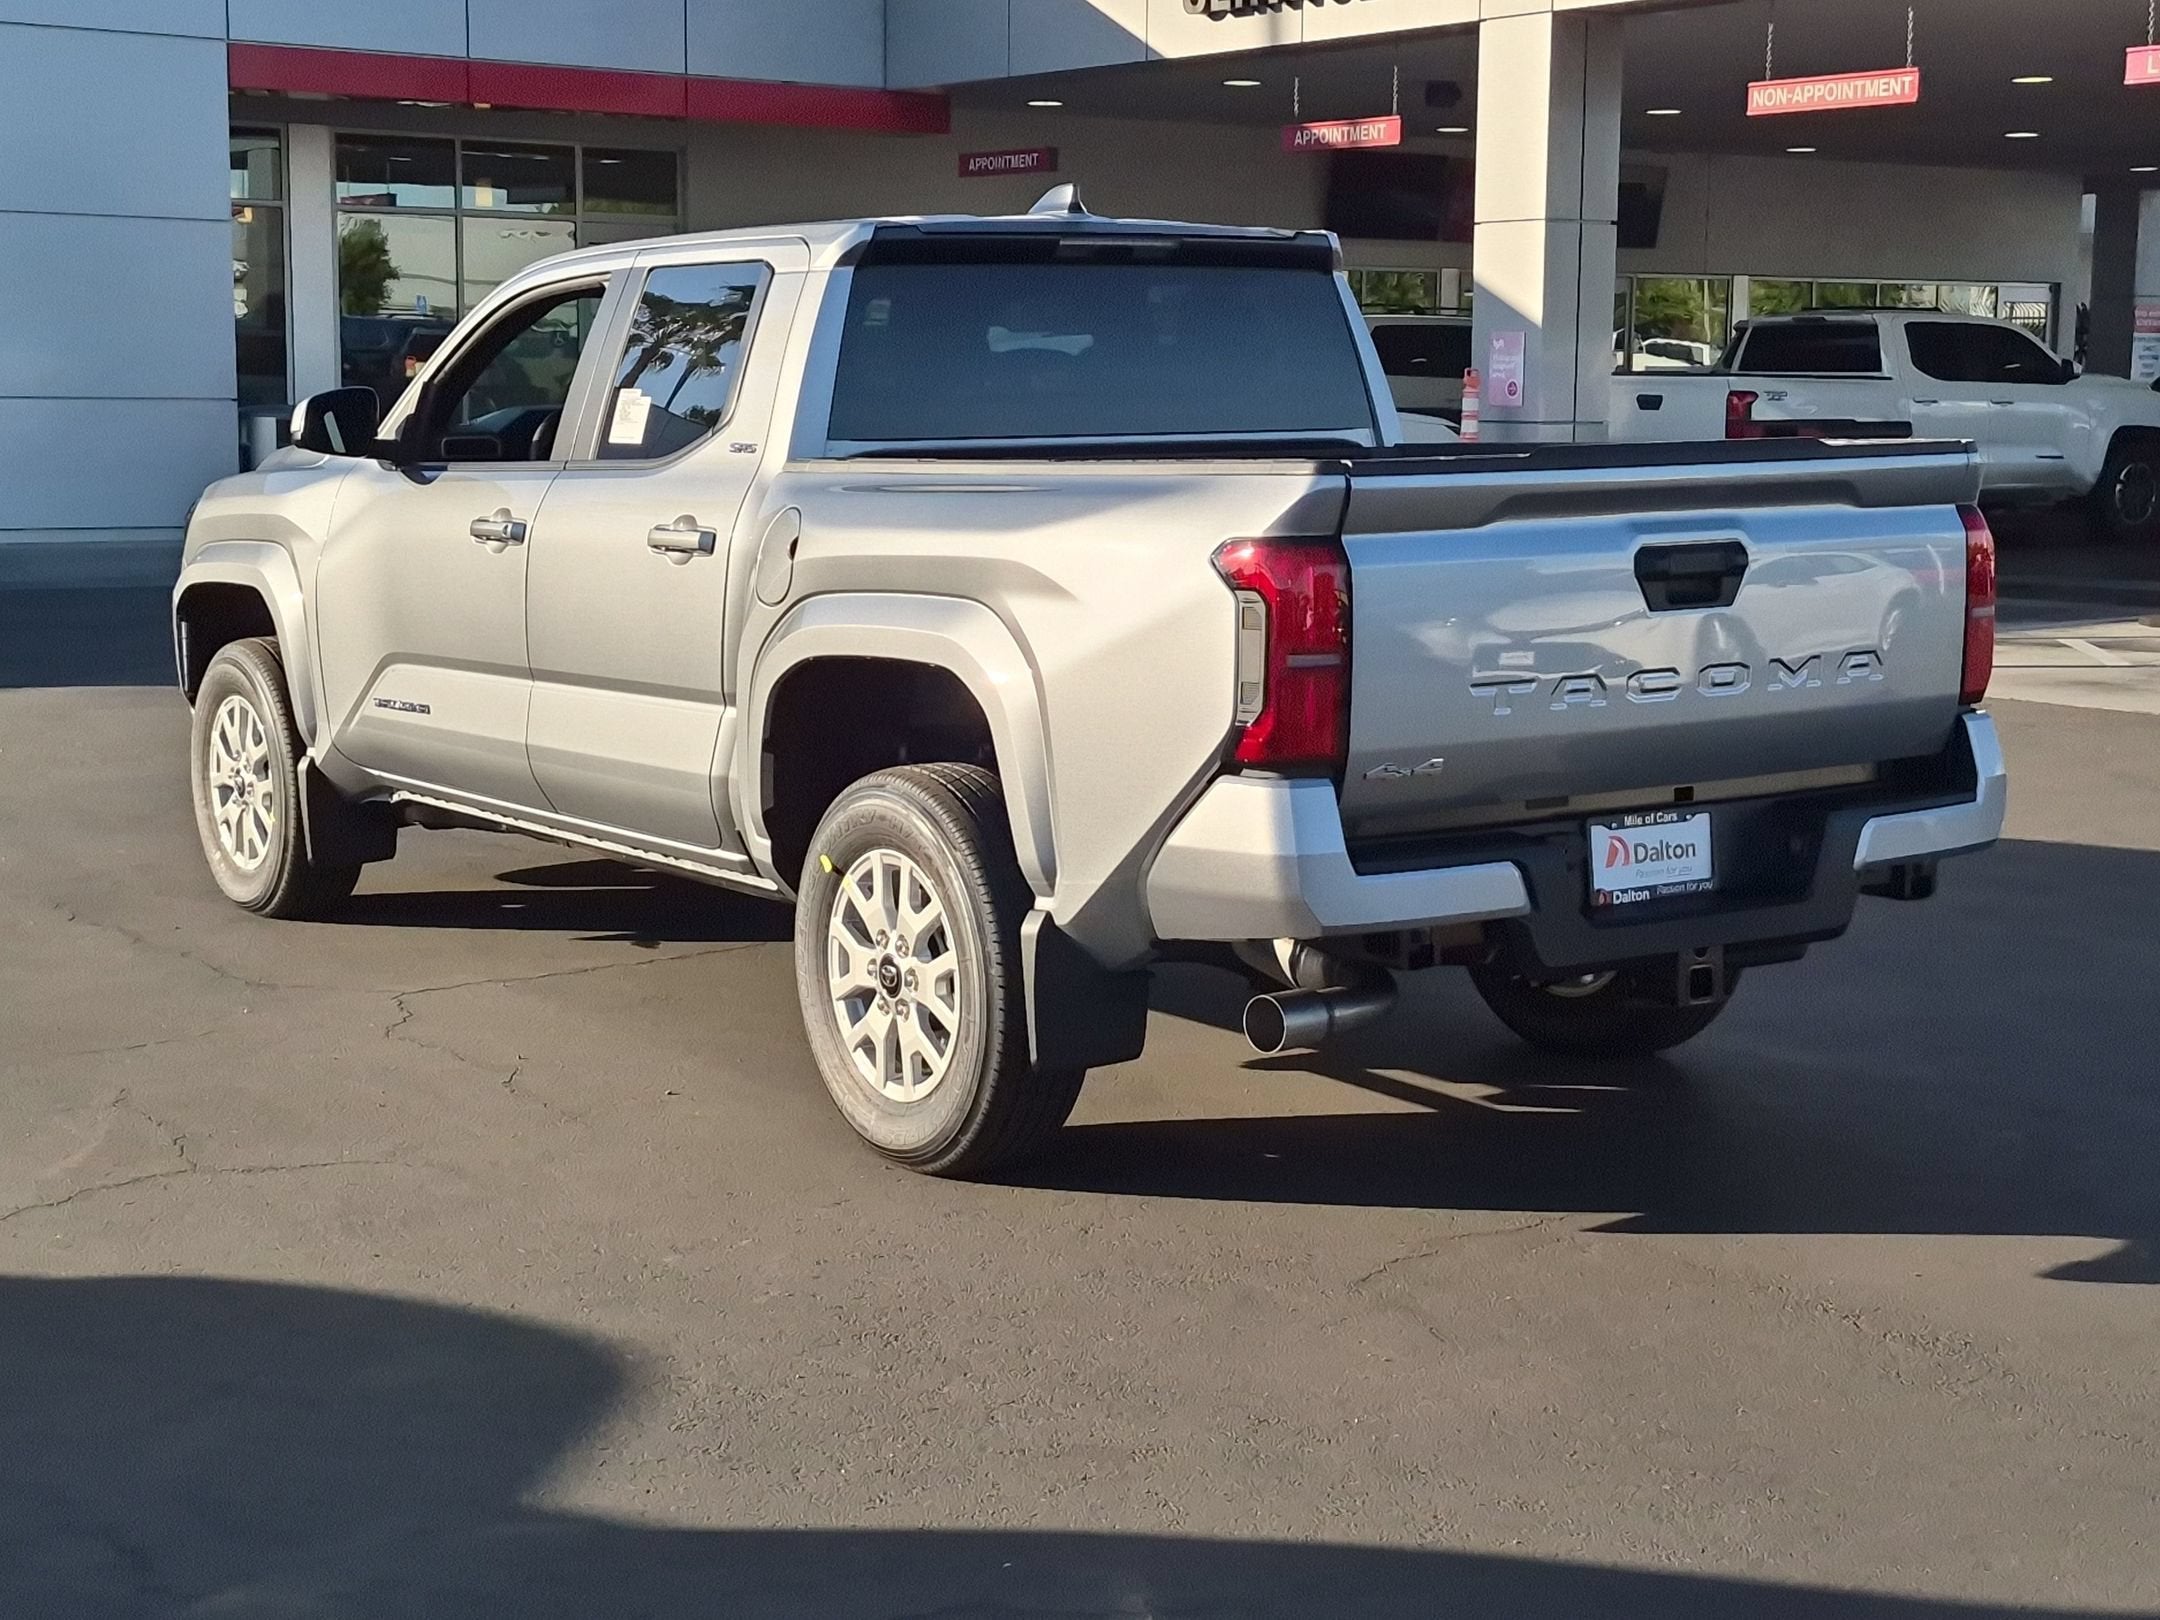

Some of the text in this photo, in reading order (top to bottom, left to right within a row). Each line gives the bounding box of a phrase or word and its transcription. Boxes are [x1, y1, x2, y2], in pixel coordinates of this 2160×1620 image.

[1752, 76, 1914, 108] NON-APPOINTMENT
[1293, 124, 1387, 146] APPOINTMENT
[968, 153, 1040, 171] APPOINTMENT
[1468, 649, 1884, 716] TACOMA
[1624, 811, 1678, 827] Mile of Cars
[1633, 839, 1696, 864] Dalton
[1613, 889, 1650, 905] Dalton
[1687, 880, 1699, 891] for
[1699, 881, 1713, 892] you
